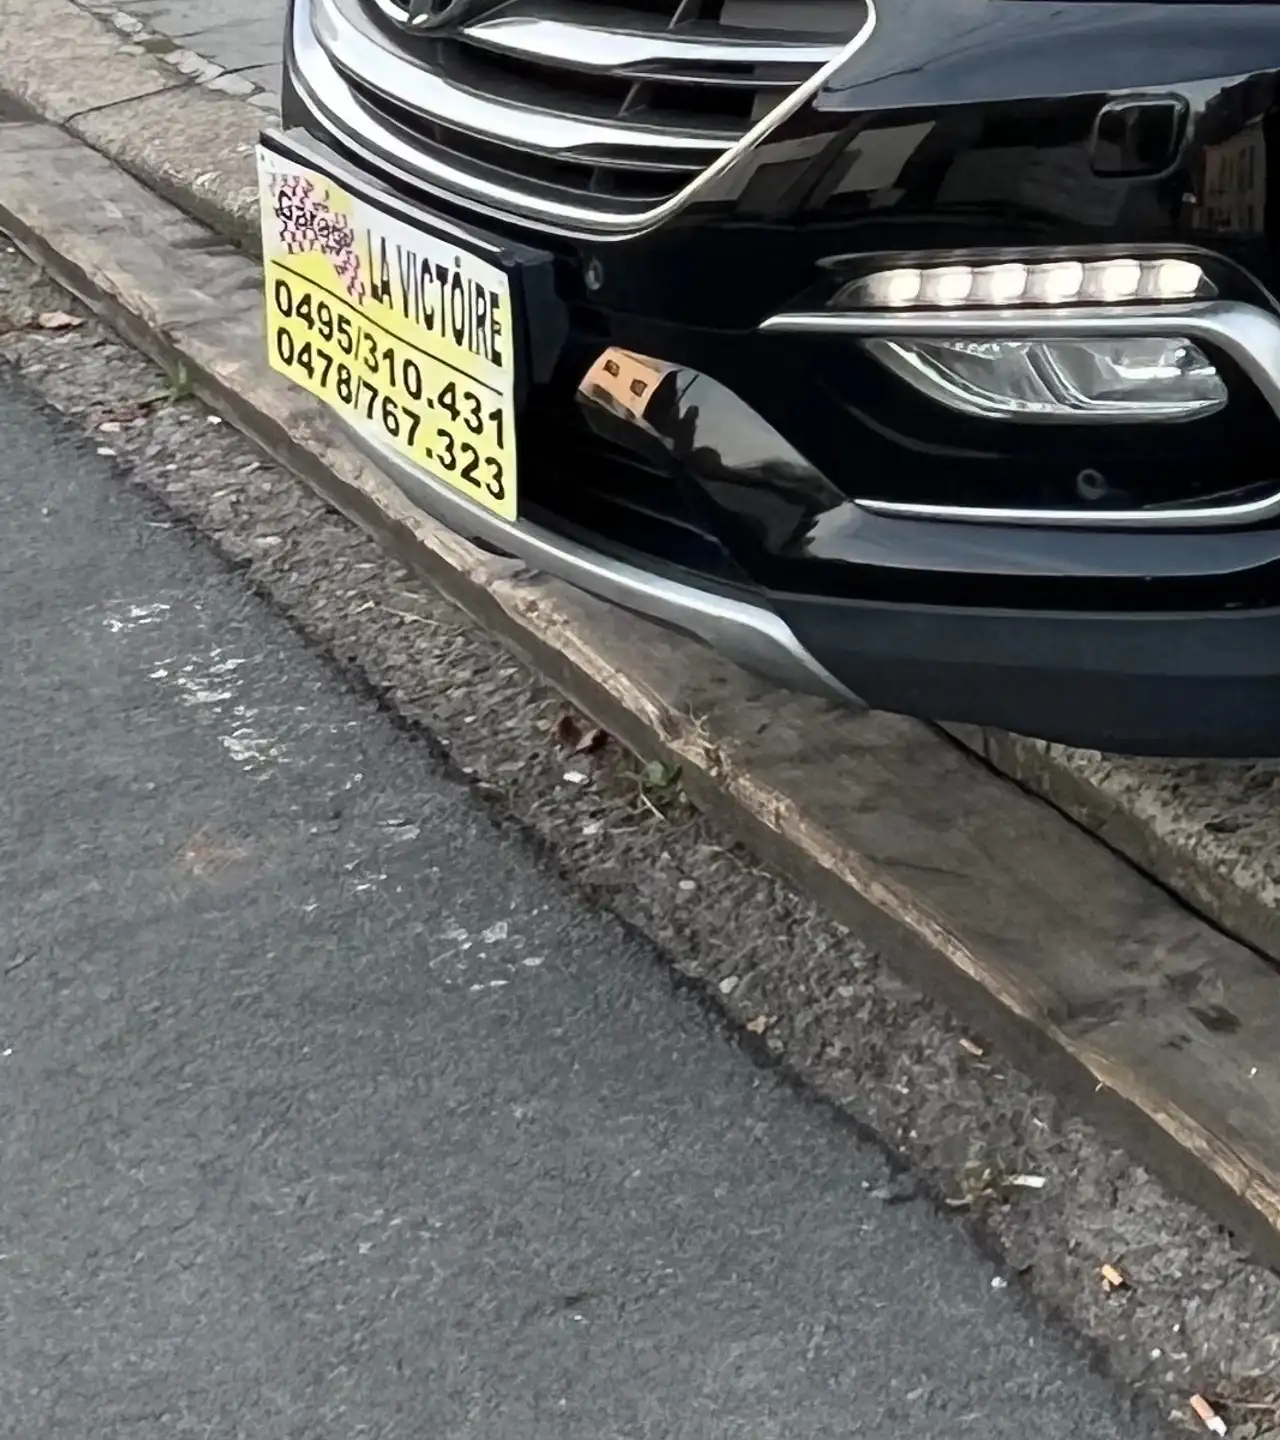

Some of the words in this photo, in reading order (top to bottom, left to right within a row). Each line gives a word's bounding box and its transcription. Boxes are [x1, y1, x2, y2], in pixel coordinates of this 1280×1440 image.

[367, 228, 394, 310] LA
[274, 278, 504, 450] 0495/310.431
[276, 326, 505, 501] 0478/767.323
